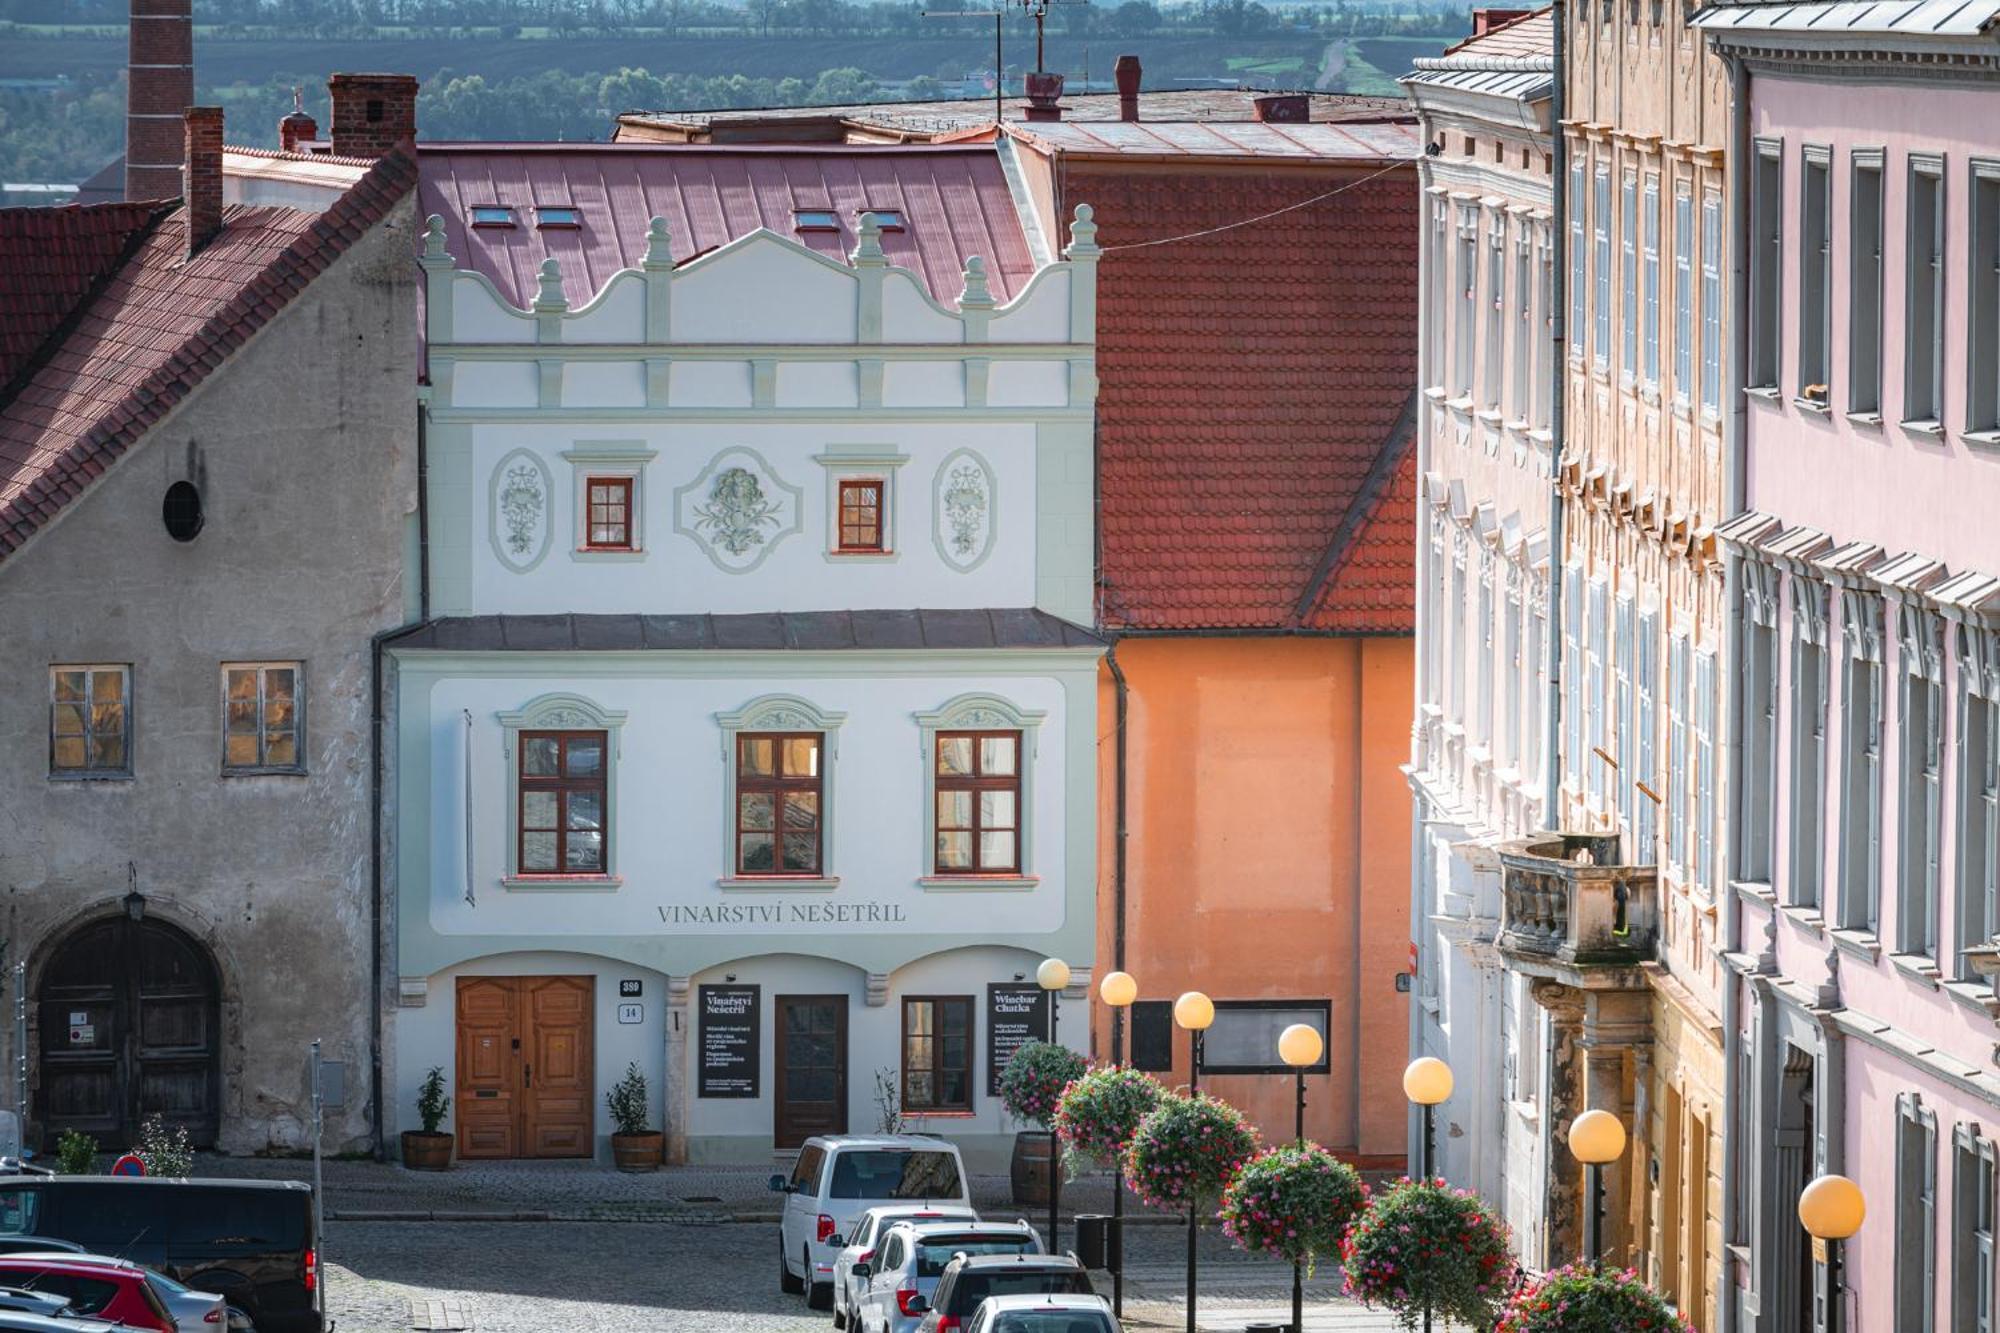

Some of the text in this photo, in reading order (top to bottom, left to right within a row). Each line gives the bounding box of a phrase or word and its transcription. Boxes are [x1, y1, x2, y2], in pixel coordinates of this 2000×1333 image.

[657, 900, 906, 923] VINAŘSTVÍ NEŠETŘIL
[706, 996, 752, 1006] Vinařství
[995, 995, 1037, 1004] Winebar
[625, 1008, 637, 1018] 14
[995, 1003, 1031, 1013] Chatka
